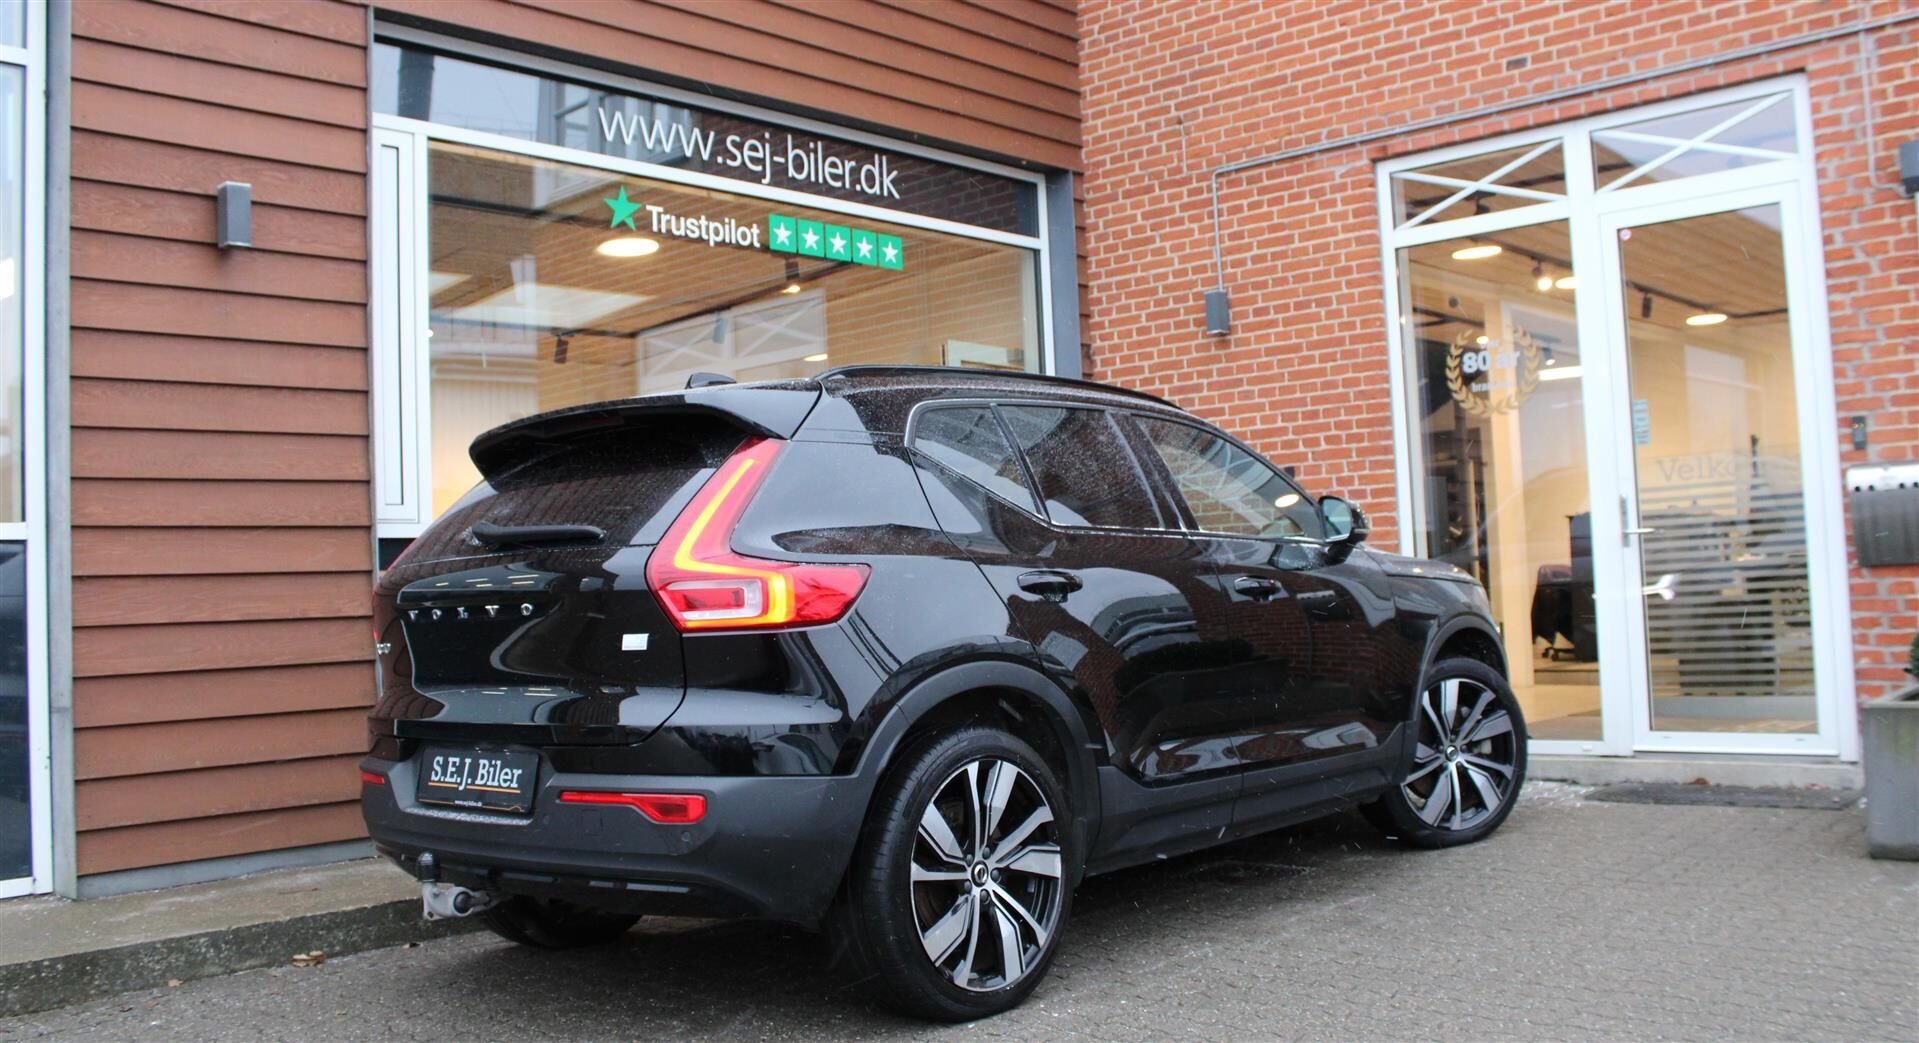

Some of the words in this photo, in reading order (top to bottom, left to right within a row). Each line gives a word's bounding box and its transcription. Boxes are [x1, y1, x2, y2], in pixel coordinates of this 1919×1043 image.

[598, 107, 899, 199] www.sej-biler.dk
[646, 204, 760, 248] Trustpilot
[1462, 351, 1491, 374] 80
[408, 603, 533, 620] VOLVO
[430, 756, 472, 791] S.E.J.
[475, 759, 522, 788] Biler
